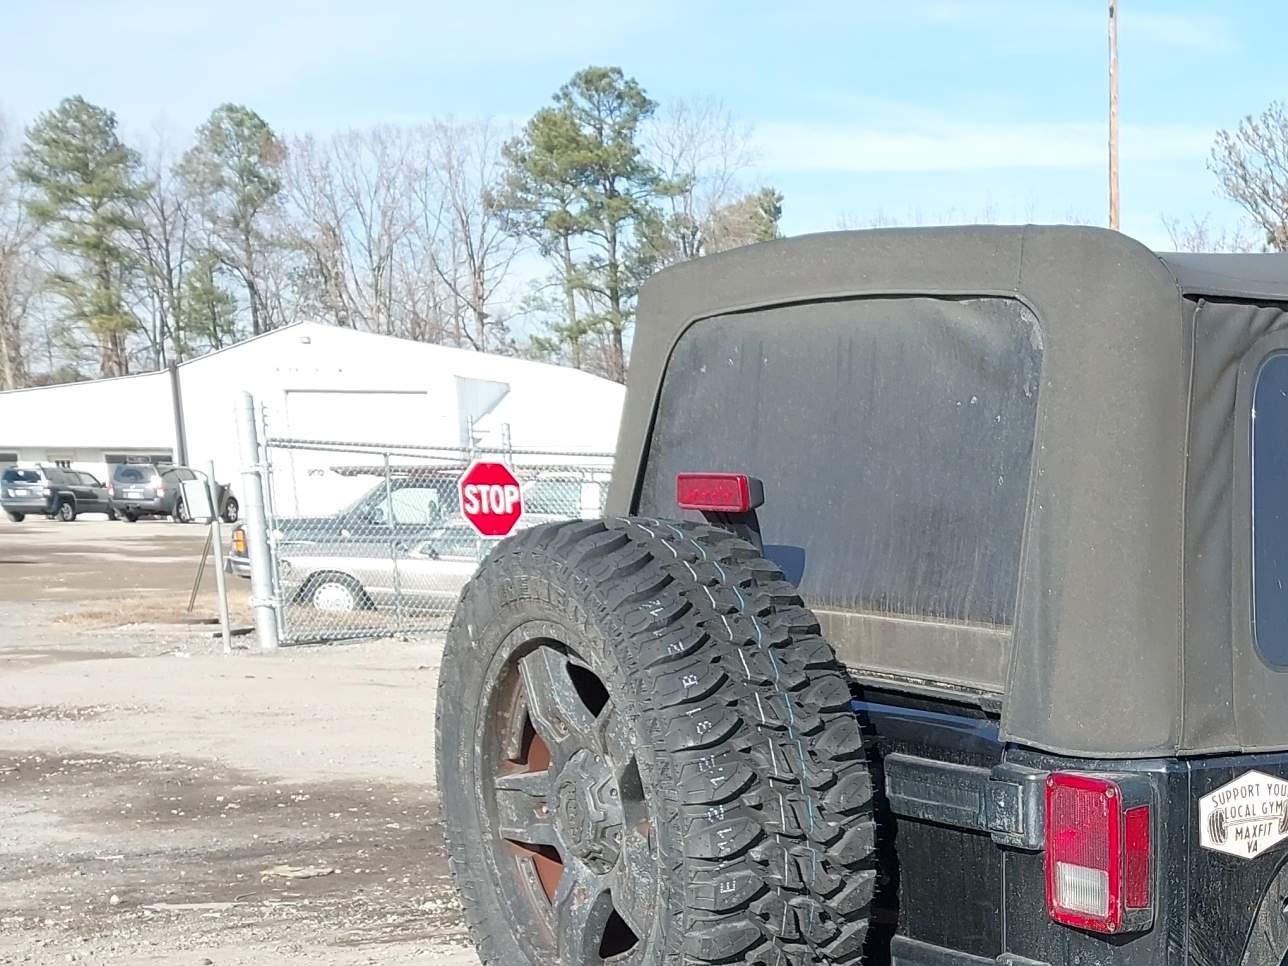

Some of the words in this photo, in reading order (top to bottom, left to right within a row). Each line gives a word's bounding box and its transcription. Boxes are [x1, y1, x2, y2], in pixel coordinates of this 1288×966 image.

[464, 484, 519, 515] STOP
[1211, 783, 1260, 808] SUPPORT
[1224, 804, 1256, 820] LOCAL
[1262, 799, 1283, 816] GYM
[1235, 822, 1273, 841] MAXFIT
[1247, 840, 1258, 853] VA
